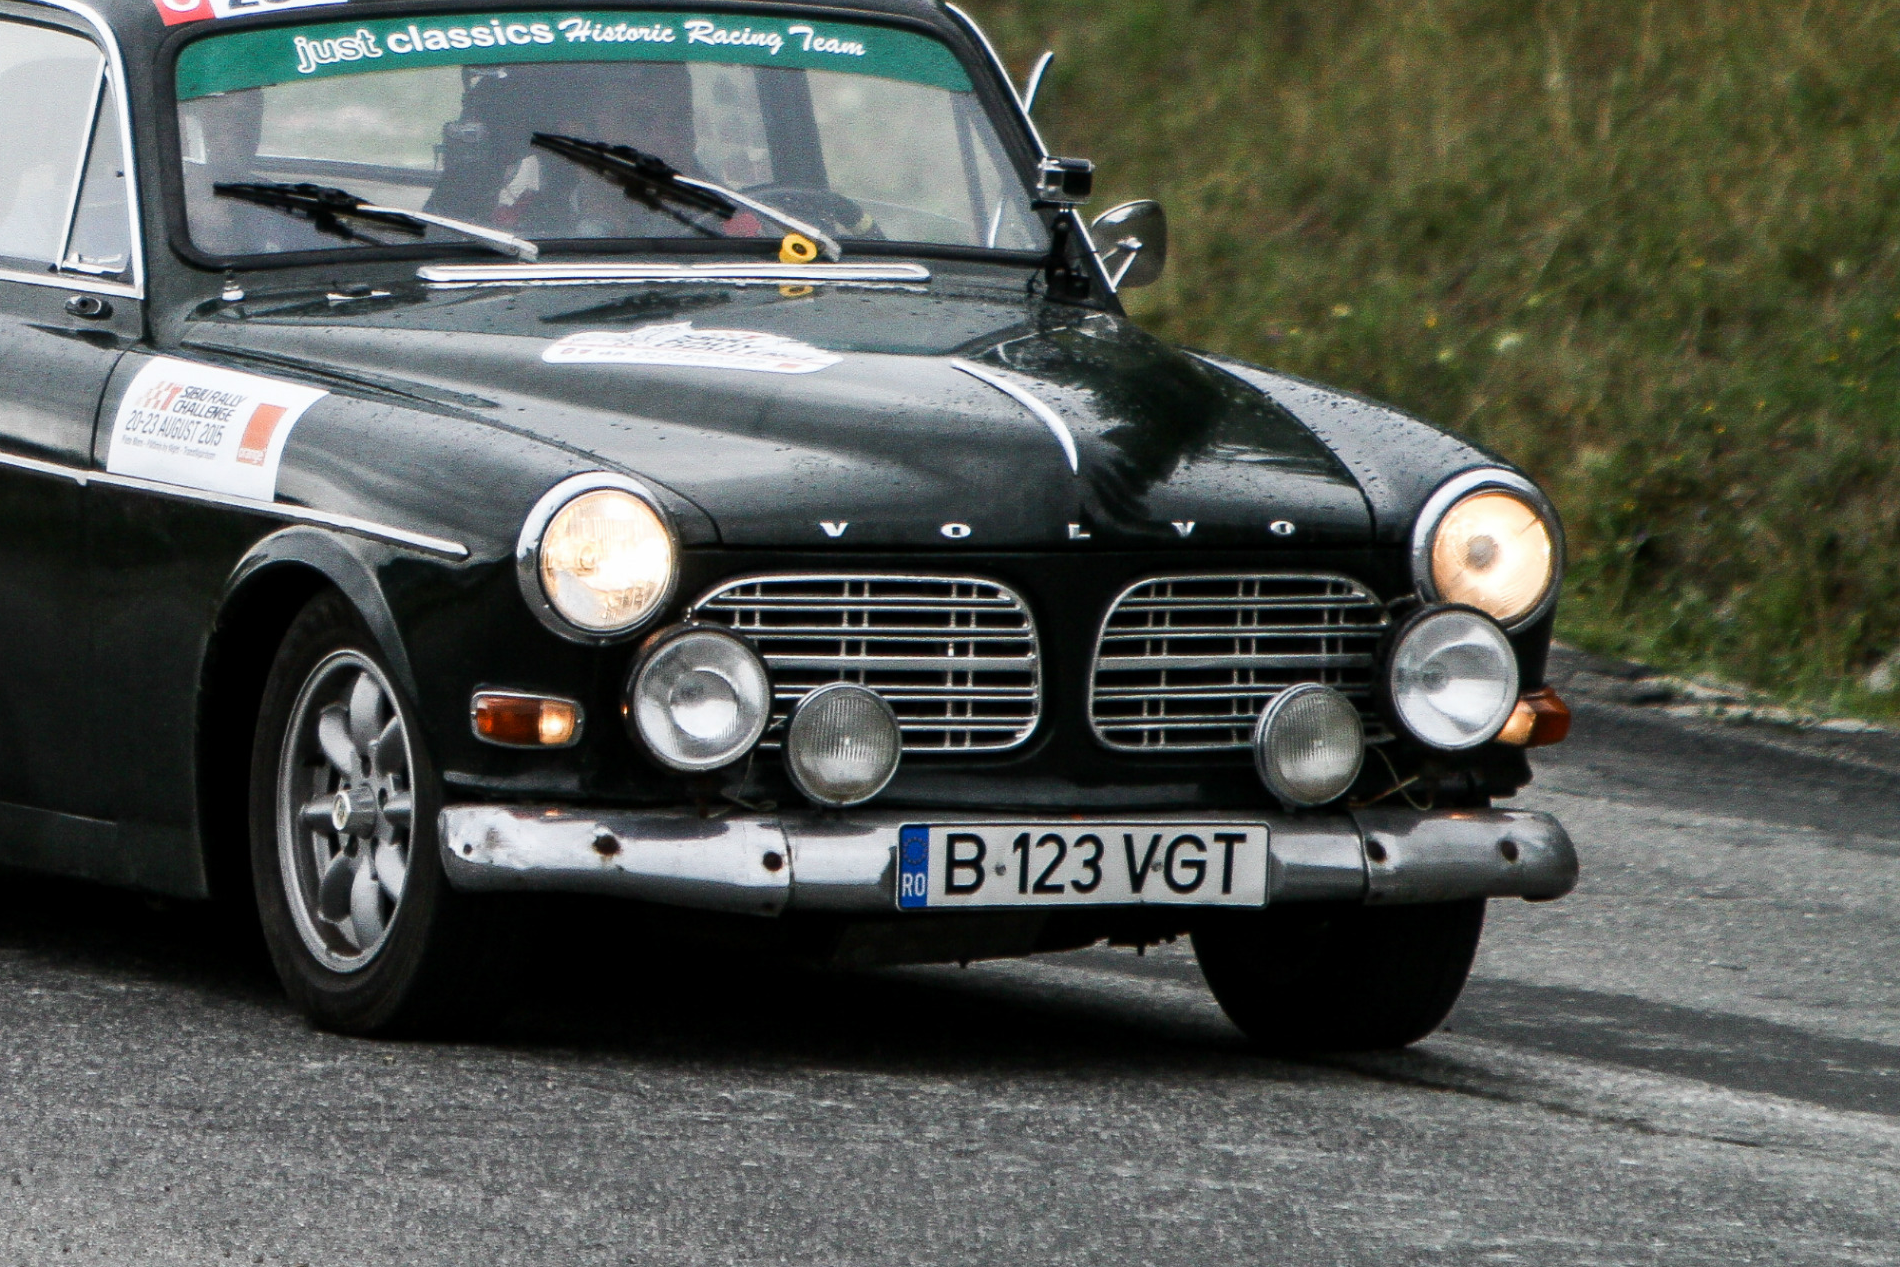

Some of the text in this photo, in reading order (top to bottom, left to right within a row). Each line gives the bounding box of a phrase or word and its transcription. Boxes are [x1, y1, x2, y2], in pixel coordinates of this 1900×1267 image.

[293, 17, 866, 74] just classics Historic Racing Team
[173, 400, 236, 422] CHALLENGE
[208, 391, 247, 407] RALLY
[125, 409, 226, 446] 20-23 AUGUST 2015
[820, 520, 1295, 539] VOLVO
[945, 833, 1247, 895] B 123 VGT
[902, 873, 926, 898] RO
